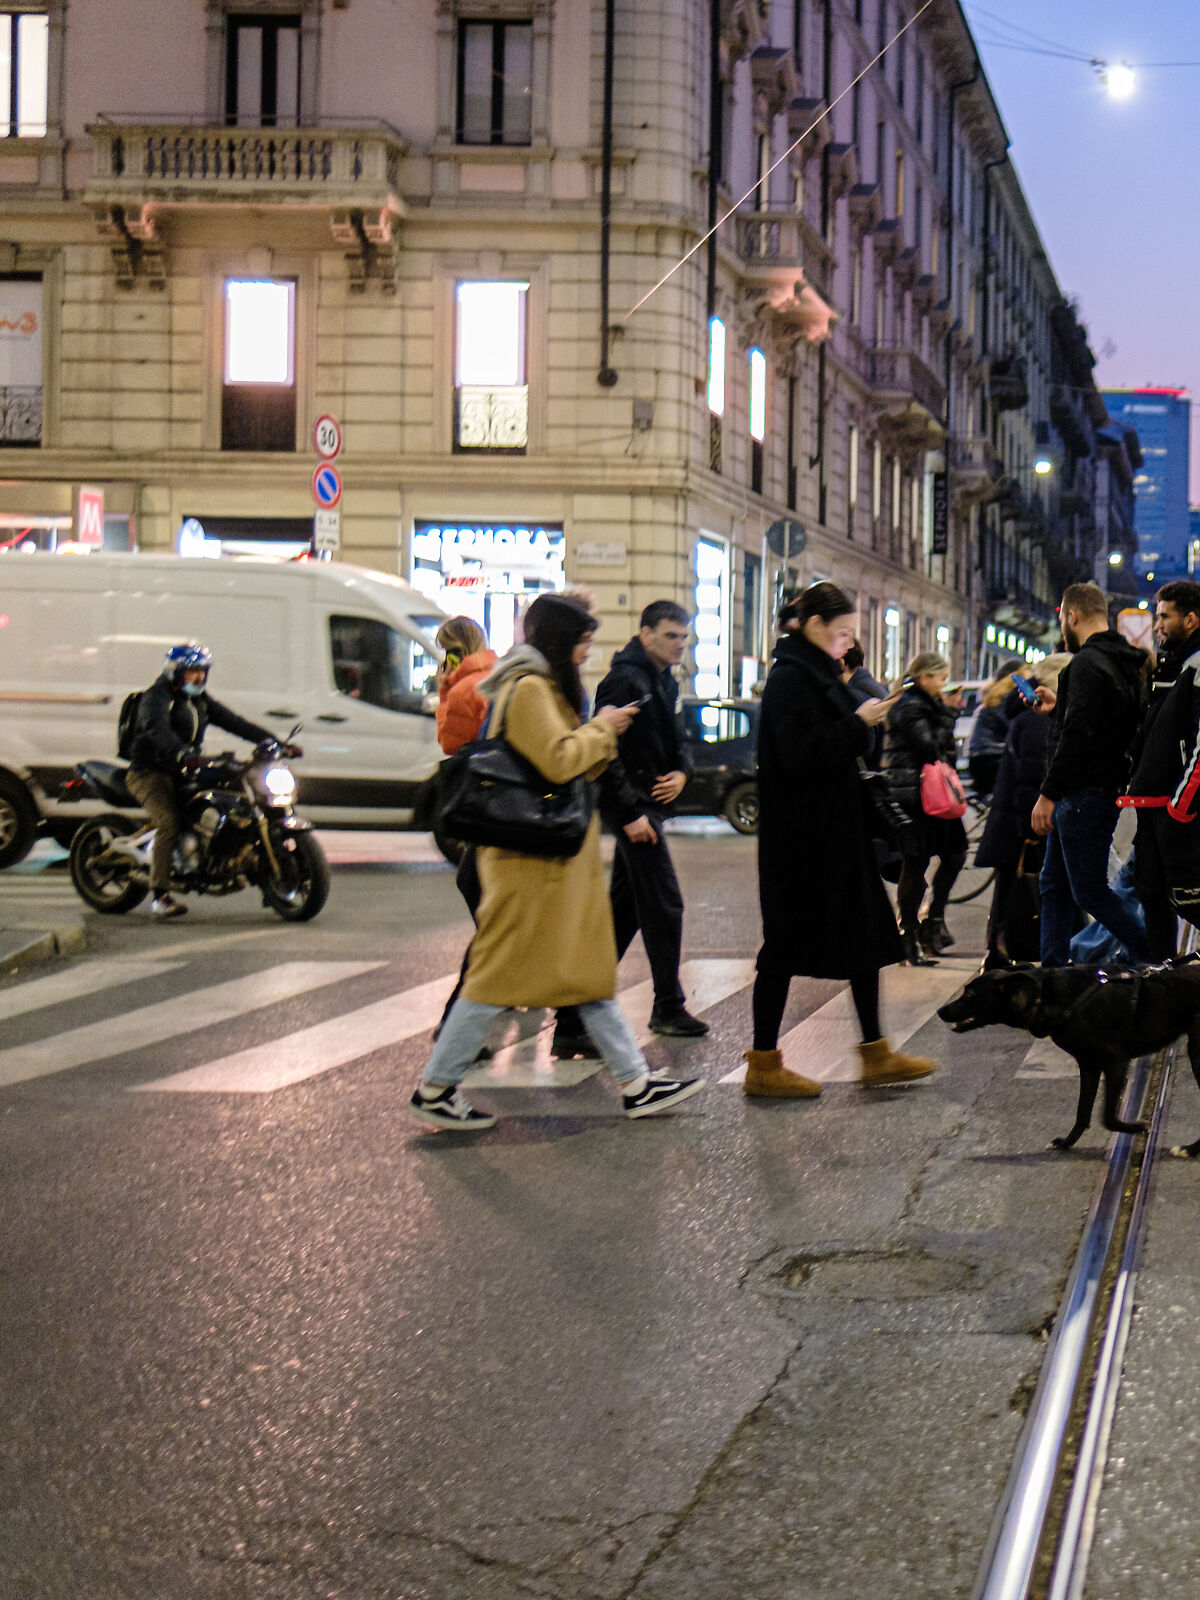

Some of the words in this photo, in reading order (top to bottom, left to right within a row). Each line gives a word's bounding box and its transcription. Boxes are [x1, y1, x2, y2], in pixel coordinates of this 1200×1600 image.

[320, 426, 335, 448] 30
[82, 501, 100, 536] M
[935, 480, 946, 548] SEPHORA
